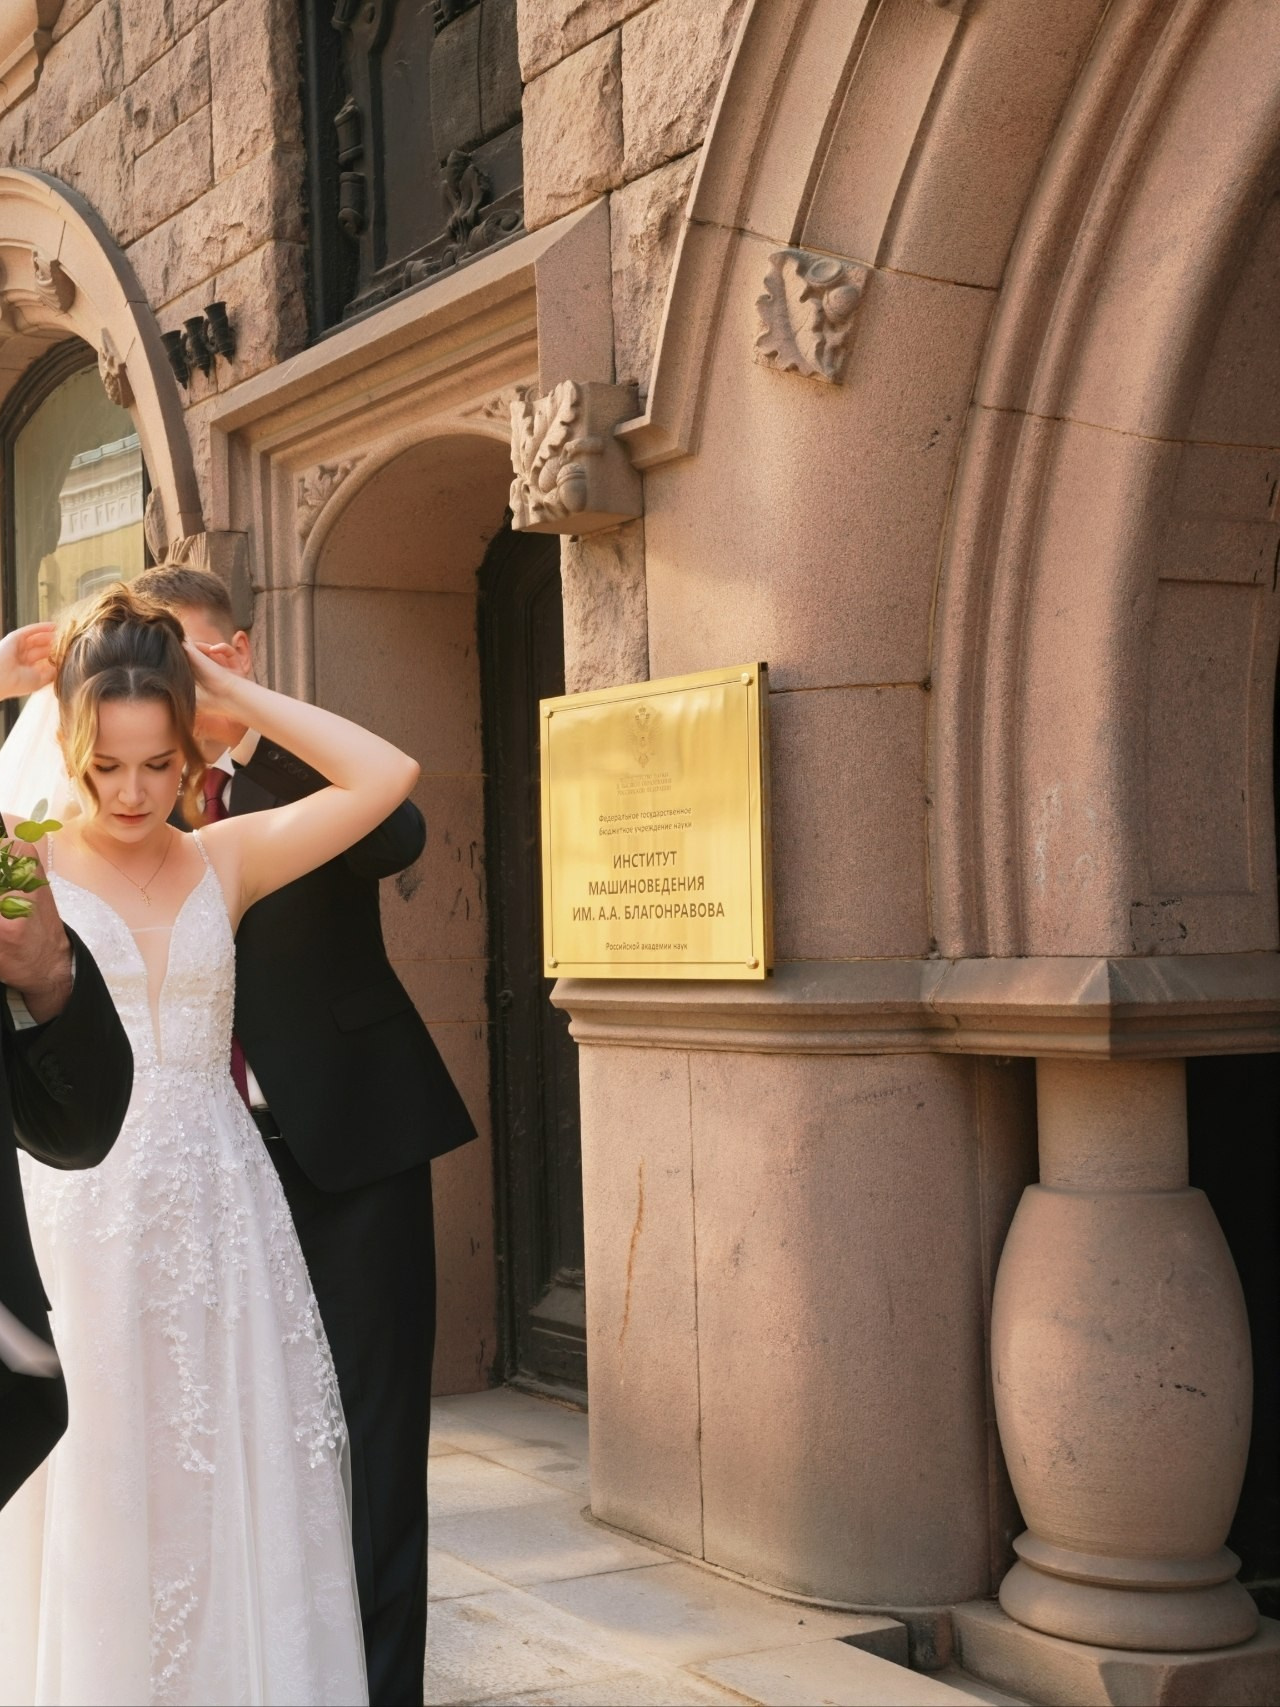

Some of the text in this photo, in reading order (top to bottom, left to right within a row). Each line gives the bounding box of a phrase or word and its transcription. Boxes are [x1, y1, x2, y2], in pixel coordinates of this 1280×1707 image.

[599, 812, 639, 823] Федеральное
[634, 823, 672, 833] учреждение
[673, 821, 692, 830] науки
[613, 850, 678, 869] ИНСТИТУТ
[588, 875, 705, 896] МАШИНОВЕДЕНИЯ
[573, 902, 725, 921] ИМ. А.А. БЛАГОНРАВОВА
[605, 942, 688, 951] Российской академии наук
